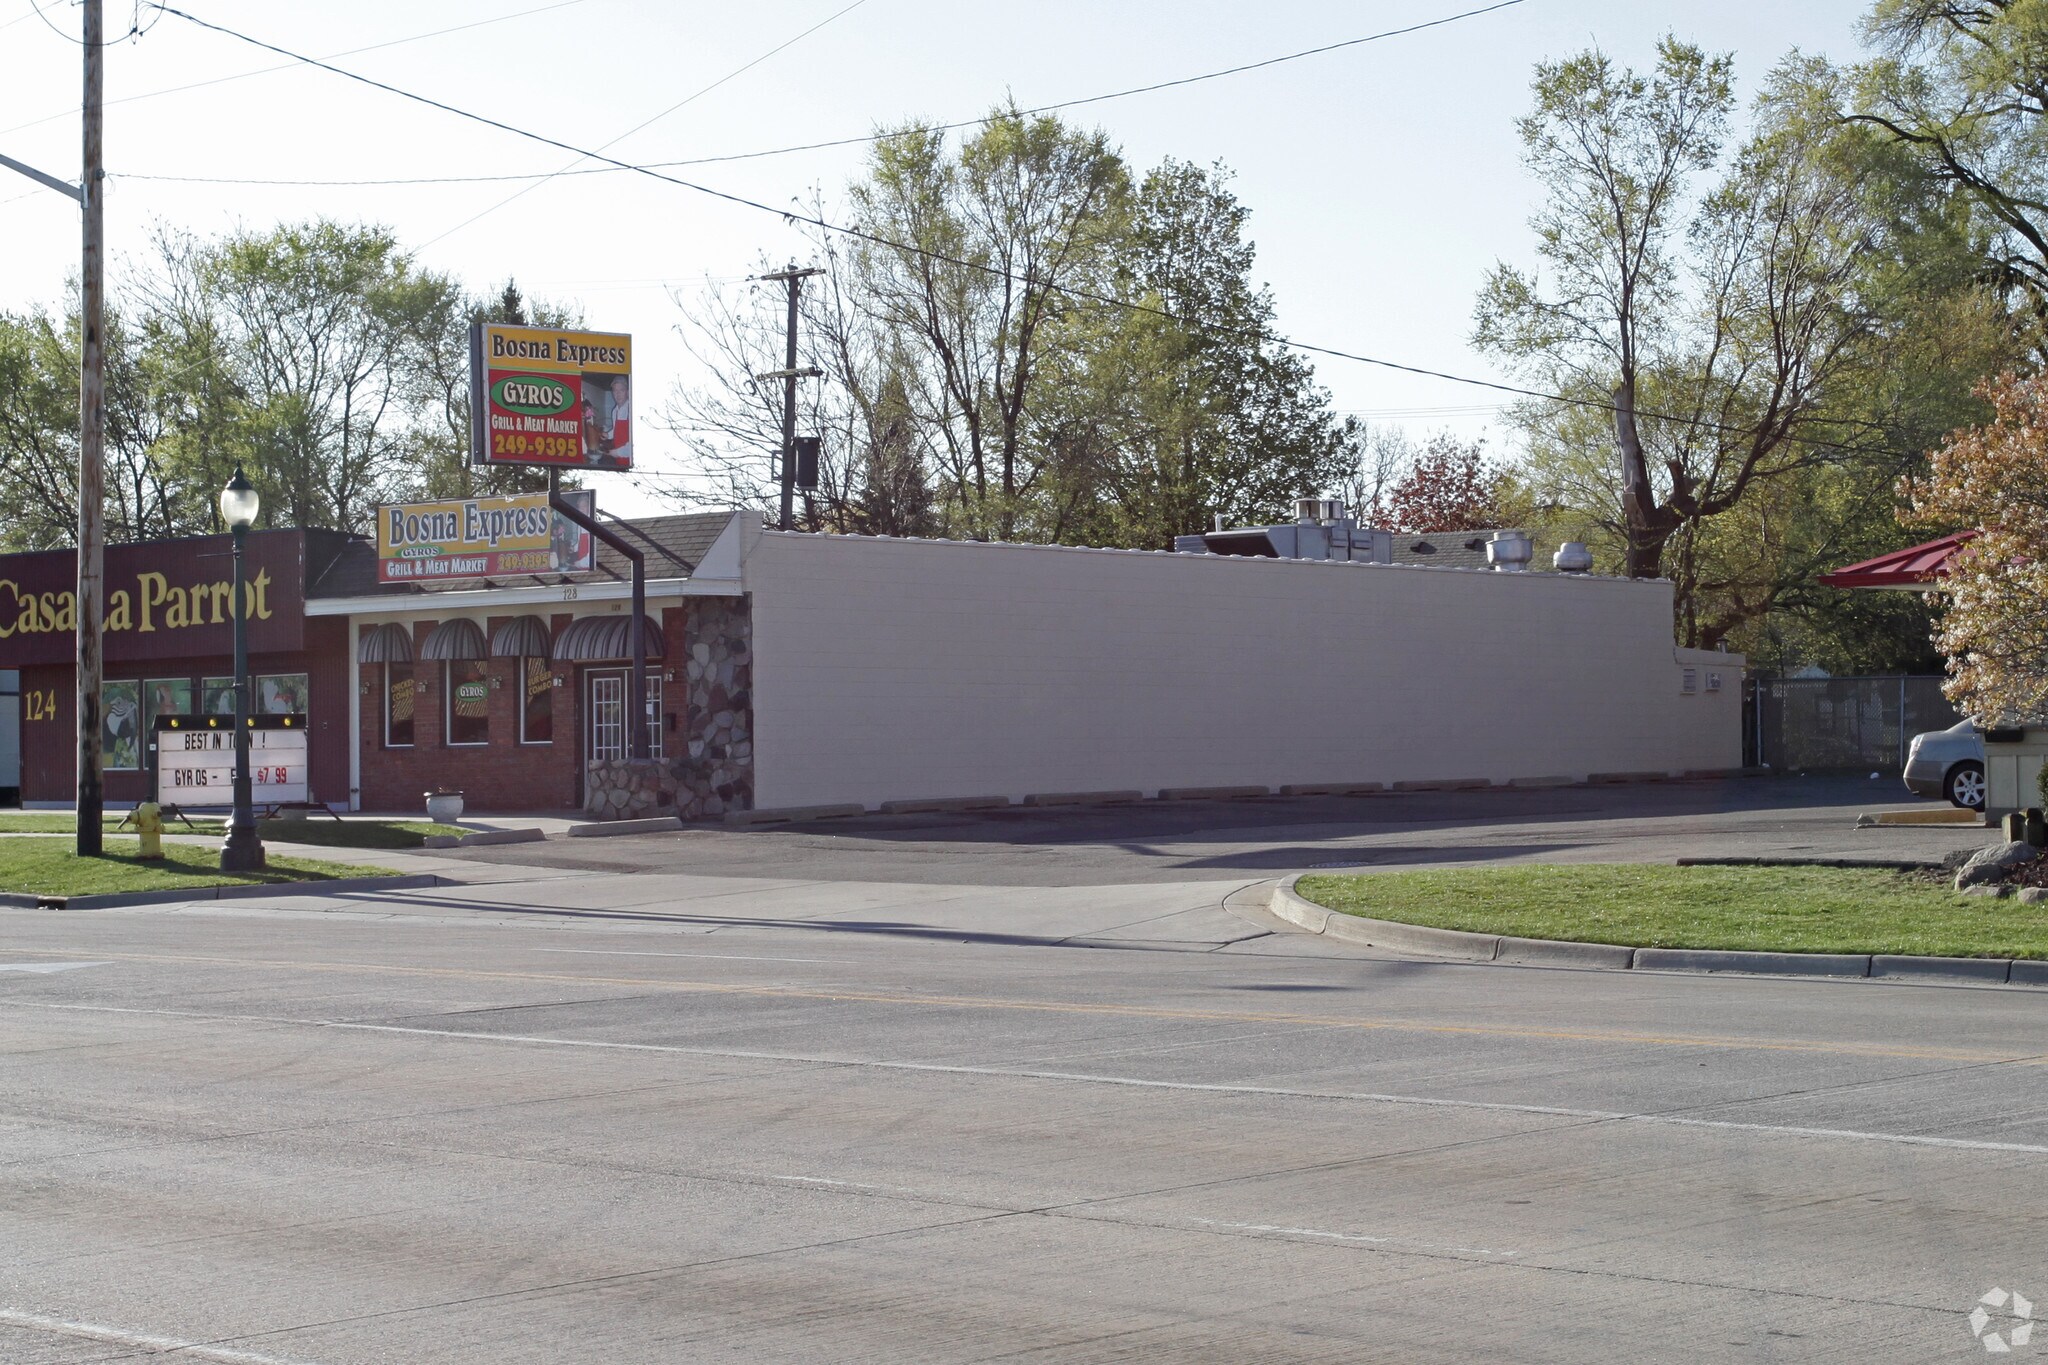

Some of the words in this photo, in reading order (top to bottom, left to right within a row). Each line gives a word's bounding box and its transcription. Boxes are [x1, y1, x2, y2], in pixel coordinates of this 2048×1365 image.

[492, 334, 551, 359] Bosna
[557, 339, 625, 366] Express
[503, 381, 563, 407] GYROS
[491, 414, 514, 431] GRILL
[516, 418, 523, 431] &
[524, 417, 545, 432] MEAT
[547, 419, 578, 434] MARKET
[495, 434, 578, 457] 249-9395
[389, 508, 458, 546] Bosna
[463, 502, 549, 547] Express
[402, 547, 439, 558] GYROS
[497, 552, 550, 571] 249-9395
[387, 561, 412, 576] GRILL
[415, 561, 423, 574] &
[426, 559, 449, 574] MEAT
[452, 557, 488, 573] MARKET
[0, 579, 77, 638] Casa
[102, 590, 133, 633] a
[137, 567, 272, 632] Parrot
[563, 588, 577, 600] 128
[460, 686, 484, 697] GYROS
[25, 689, 56, 721] 124
[185, 733, 208, 750] BEST
[212, 733, 221, 750] IN
[228, 732, 253, 749] TN
